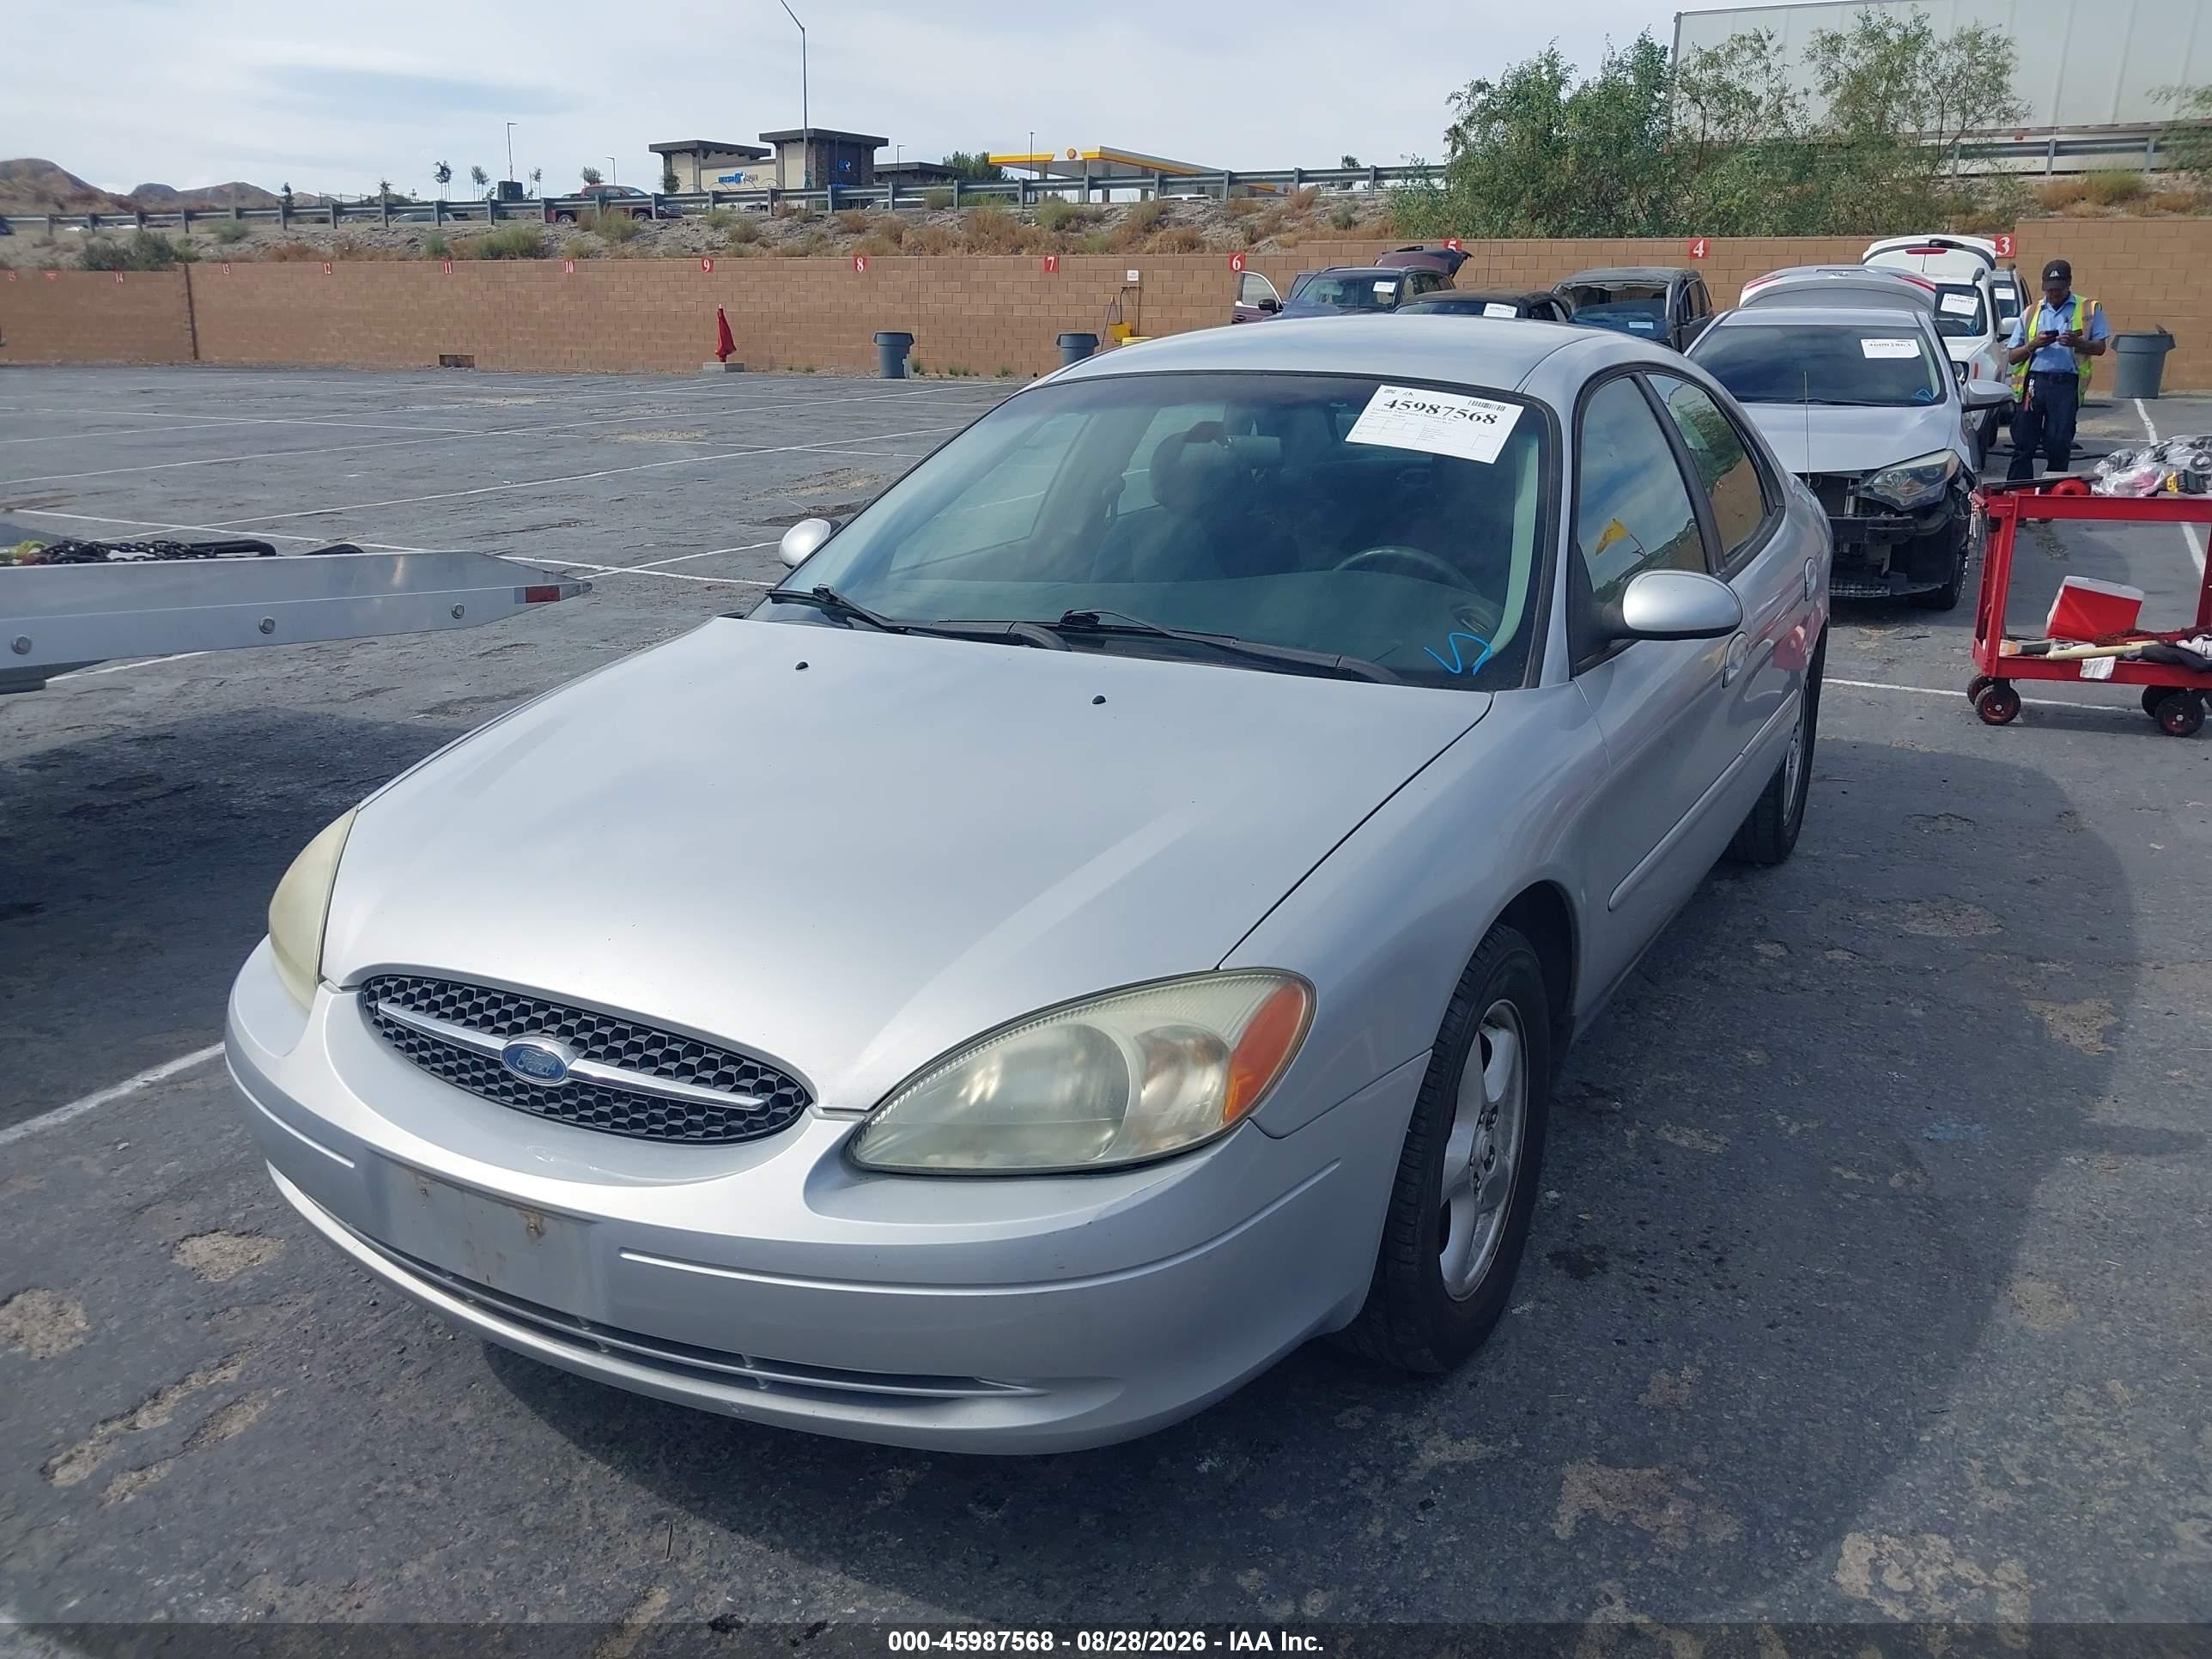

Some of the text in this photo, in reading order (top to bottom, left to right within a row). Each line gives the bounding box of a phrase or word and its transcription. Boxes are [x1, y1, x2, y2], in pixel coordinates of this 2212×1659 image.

[1447, 240, 1457, 252] 5
[1692, 240, 1705, 258] 4
[1996, 236, 2010, 256] 3
[323, 262, 331, 275] 12
[444, 261, 453, 274] 11
[565, 260, 574, 274] 10
[703, 258, 711, 272] 9
[856, 257, 865, 273] 8
[1047, 256, 1055, 271] 7
[1232, 254, 1241, 270] 6
[1383, 398, 1498, 425] 45987568
